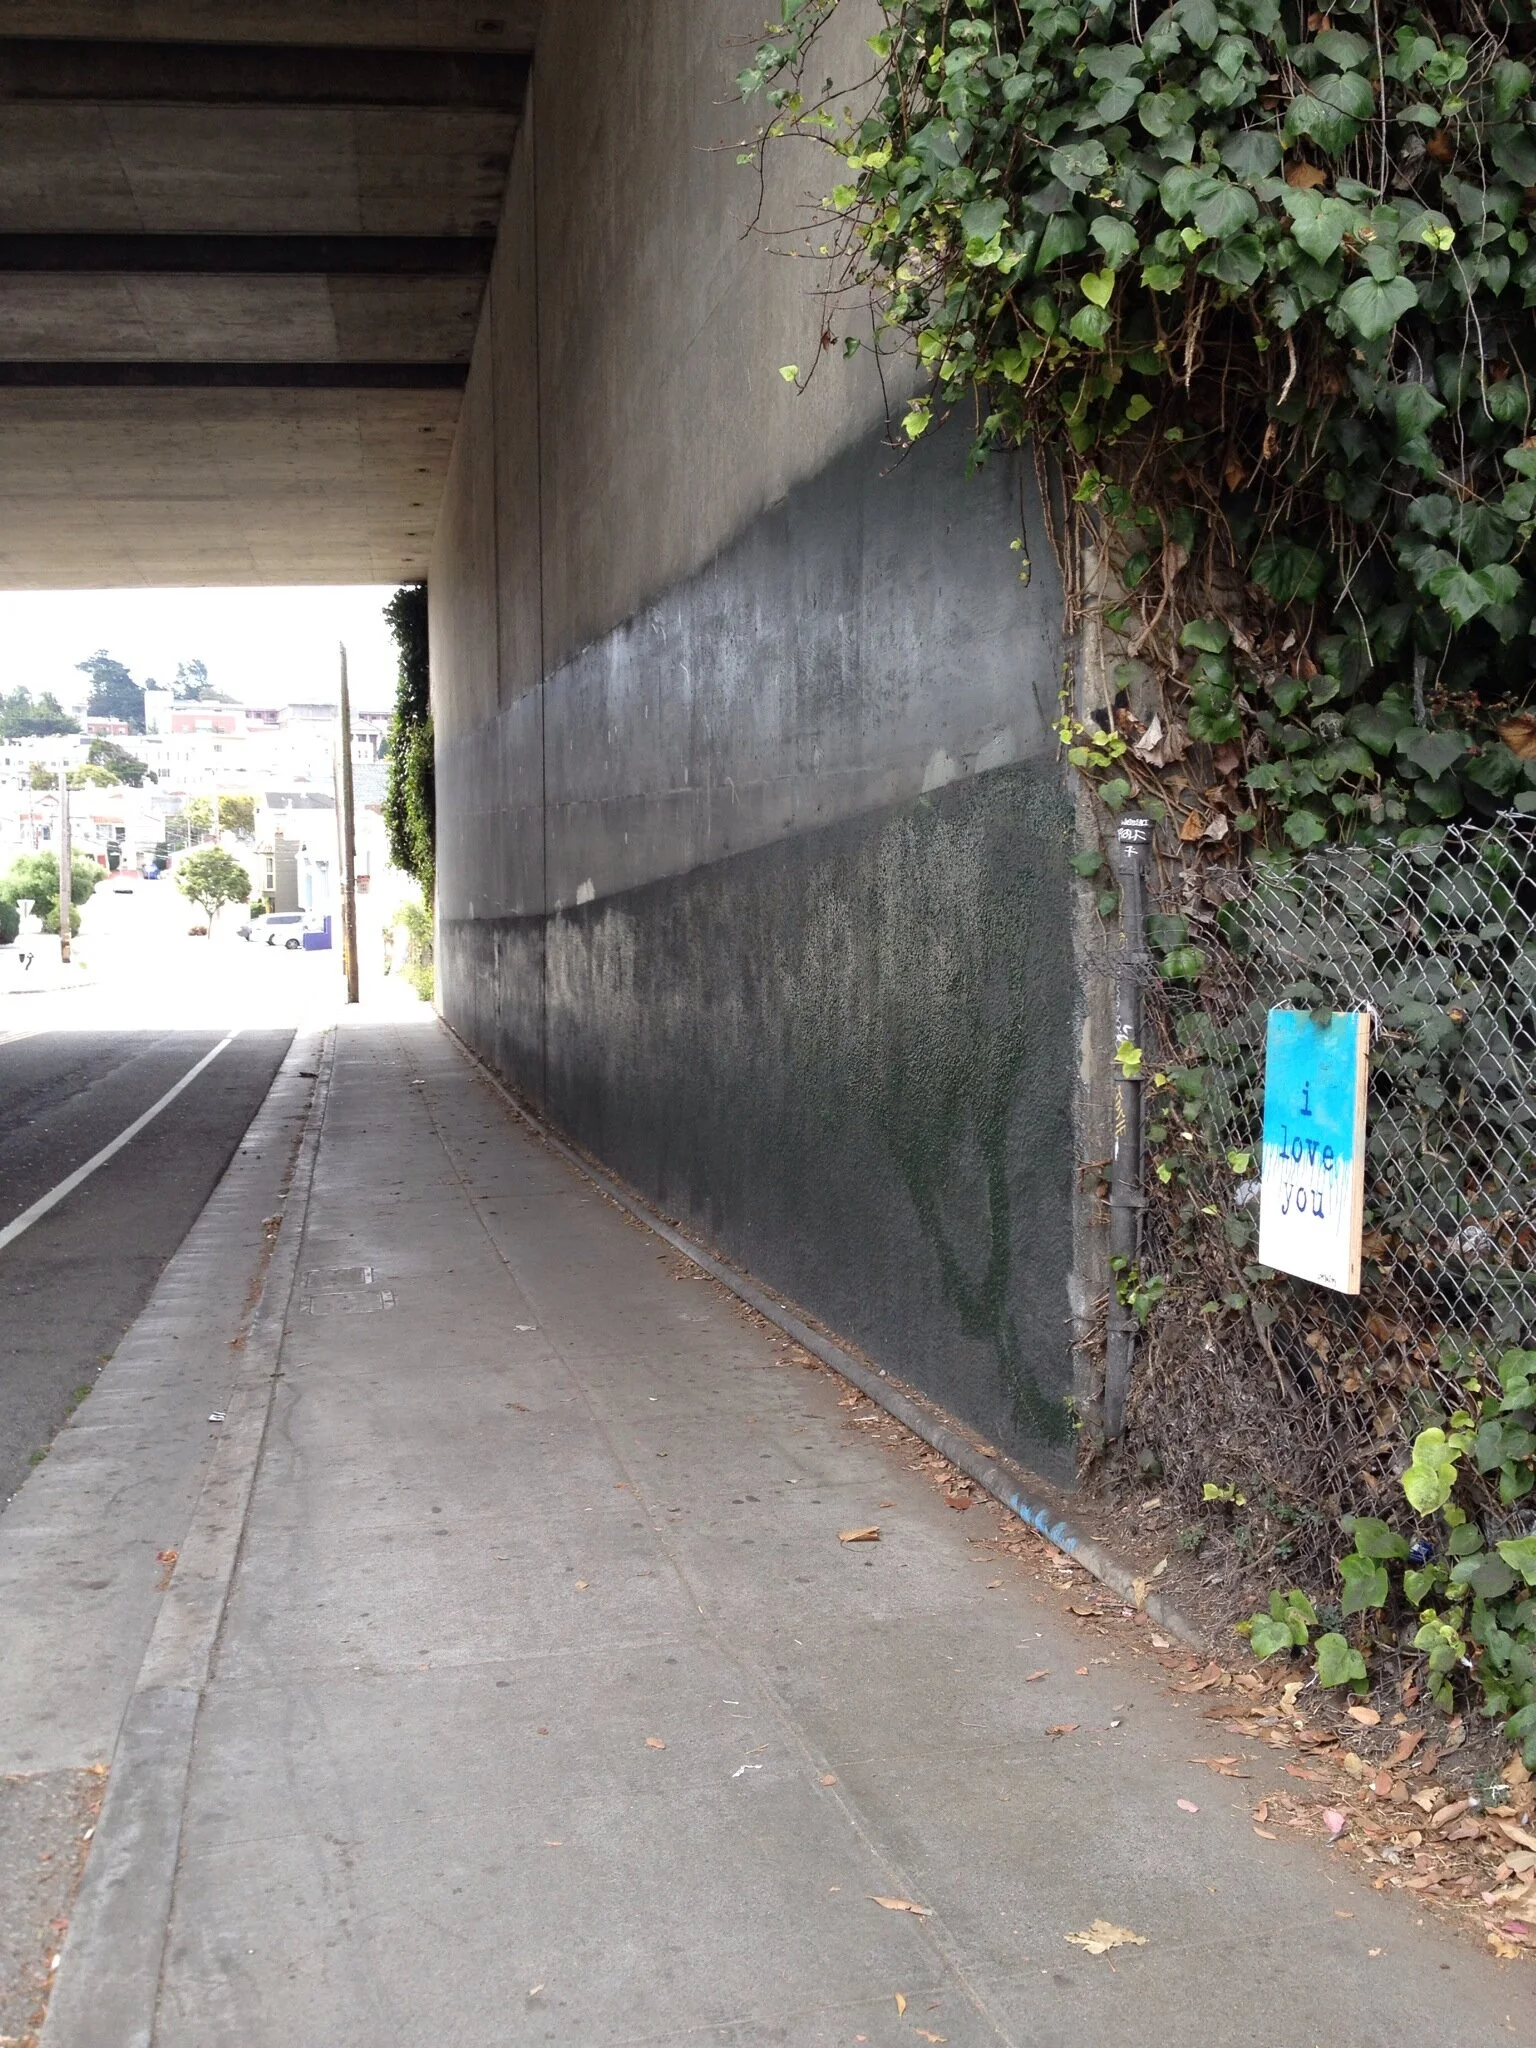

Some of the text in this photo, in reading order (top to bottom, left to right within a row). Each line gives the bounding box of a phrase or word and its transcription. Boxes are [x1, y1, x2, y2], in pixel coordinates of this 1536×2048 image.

[1300, 1081, 1312, 1116] i
[1280, 1124, 1334, 1171] love
[1281, 1182, 1325, 1219] you
